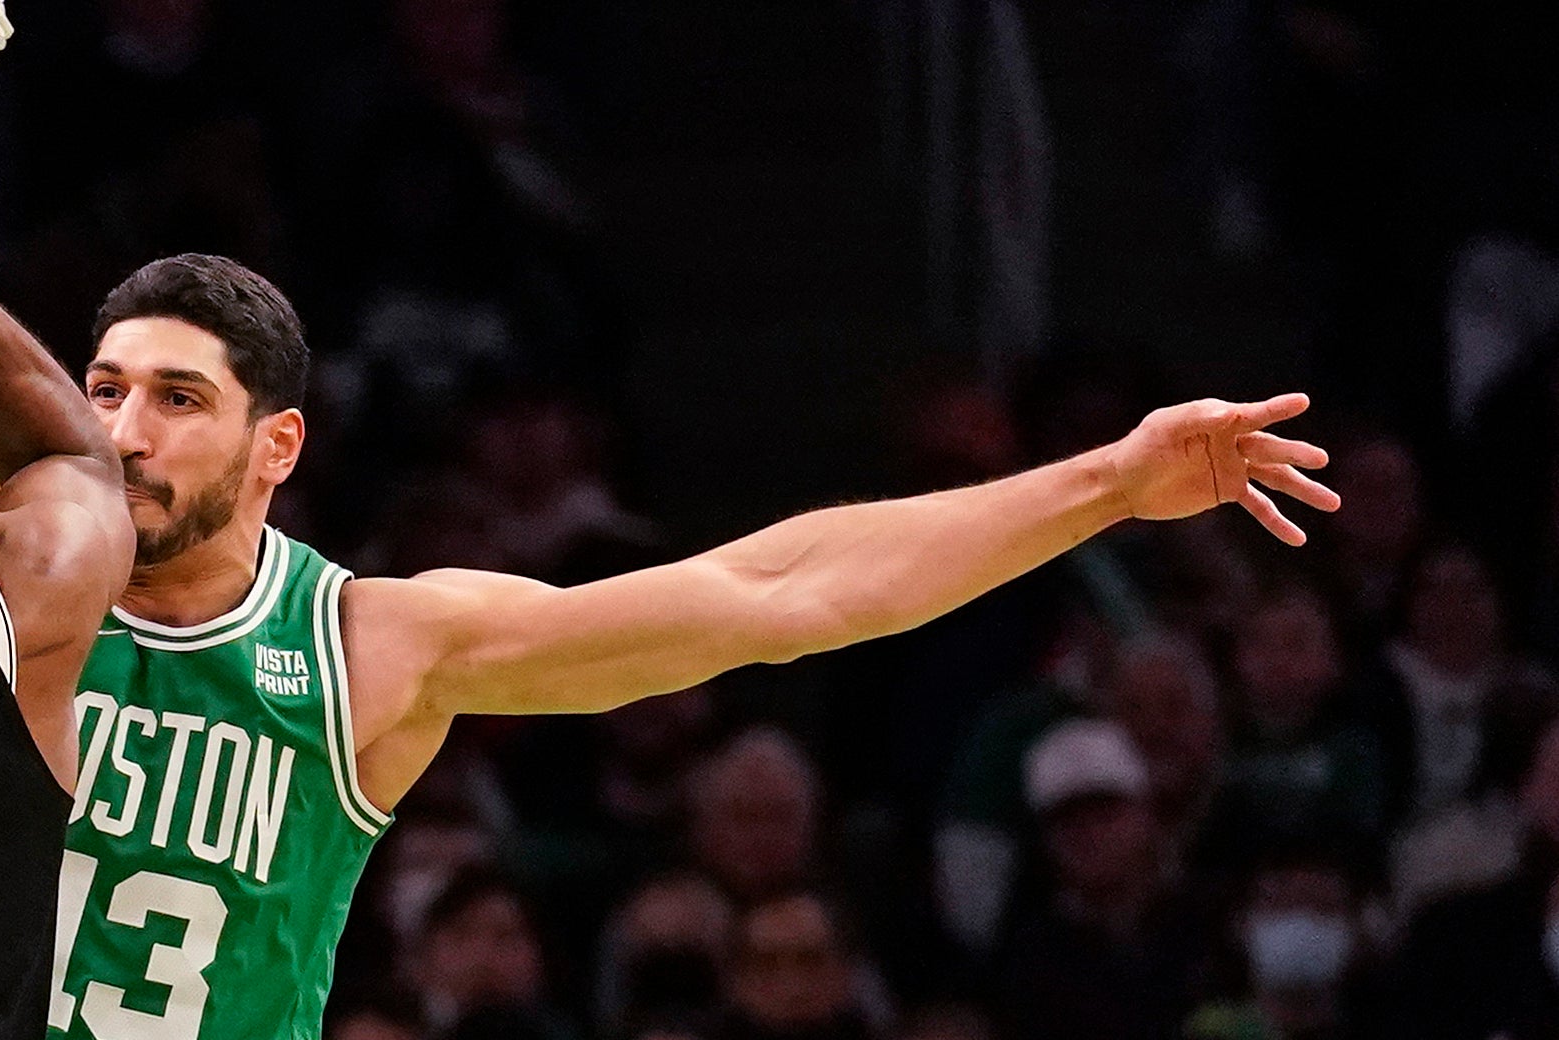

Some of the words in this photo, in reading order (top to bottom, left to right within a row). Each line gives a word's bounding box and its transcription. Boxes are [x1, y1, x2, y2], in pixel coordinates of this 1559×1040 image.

[255, 642, 309, 674] VISTA
[255, 667, 310, 696] PRINT
[68, 690, 296, 884] OSTON
